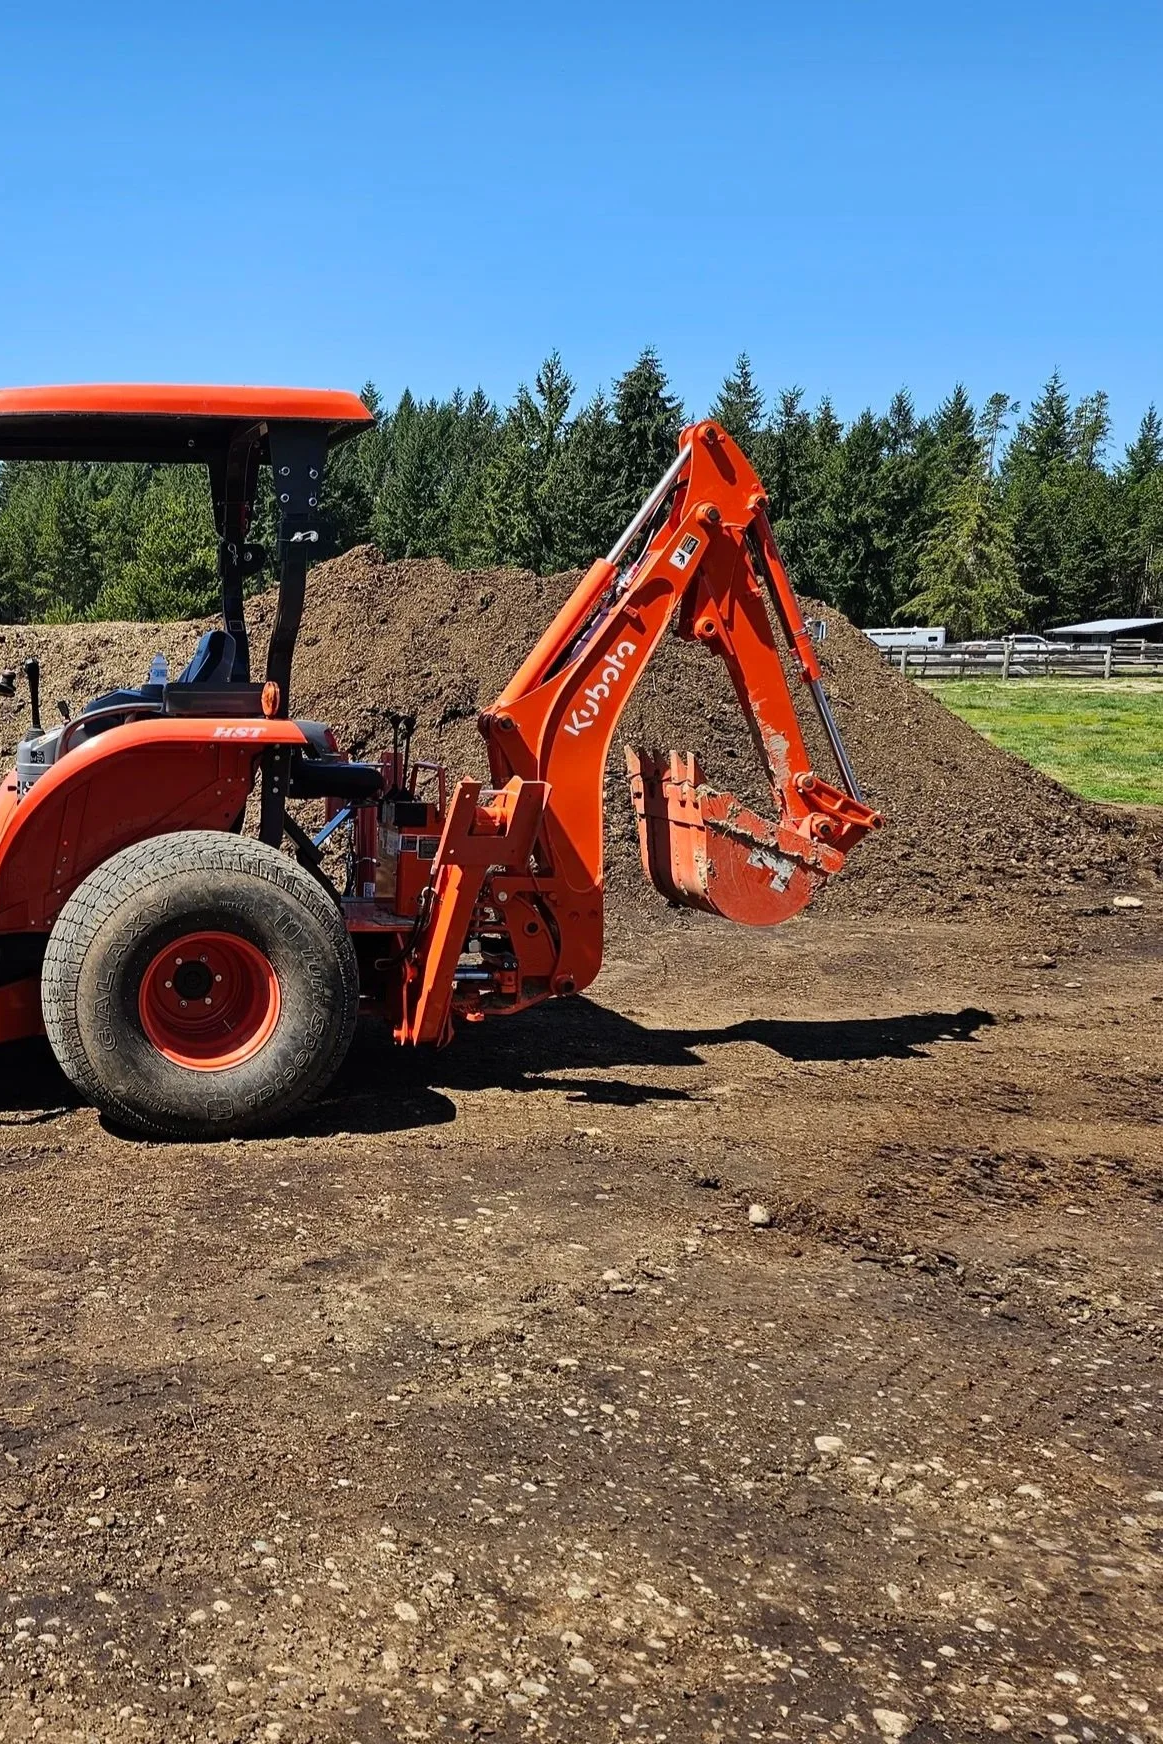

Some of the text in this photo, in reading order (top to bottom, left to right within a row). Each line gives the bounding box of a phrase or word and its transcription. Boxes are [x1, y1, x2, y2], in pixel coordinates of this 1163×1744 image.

[212, 726, 267, 739] HST
[563, 640, 637, 737] Kubota
[93, 895, 171, 1052] GALAXY
